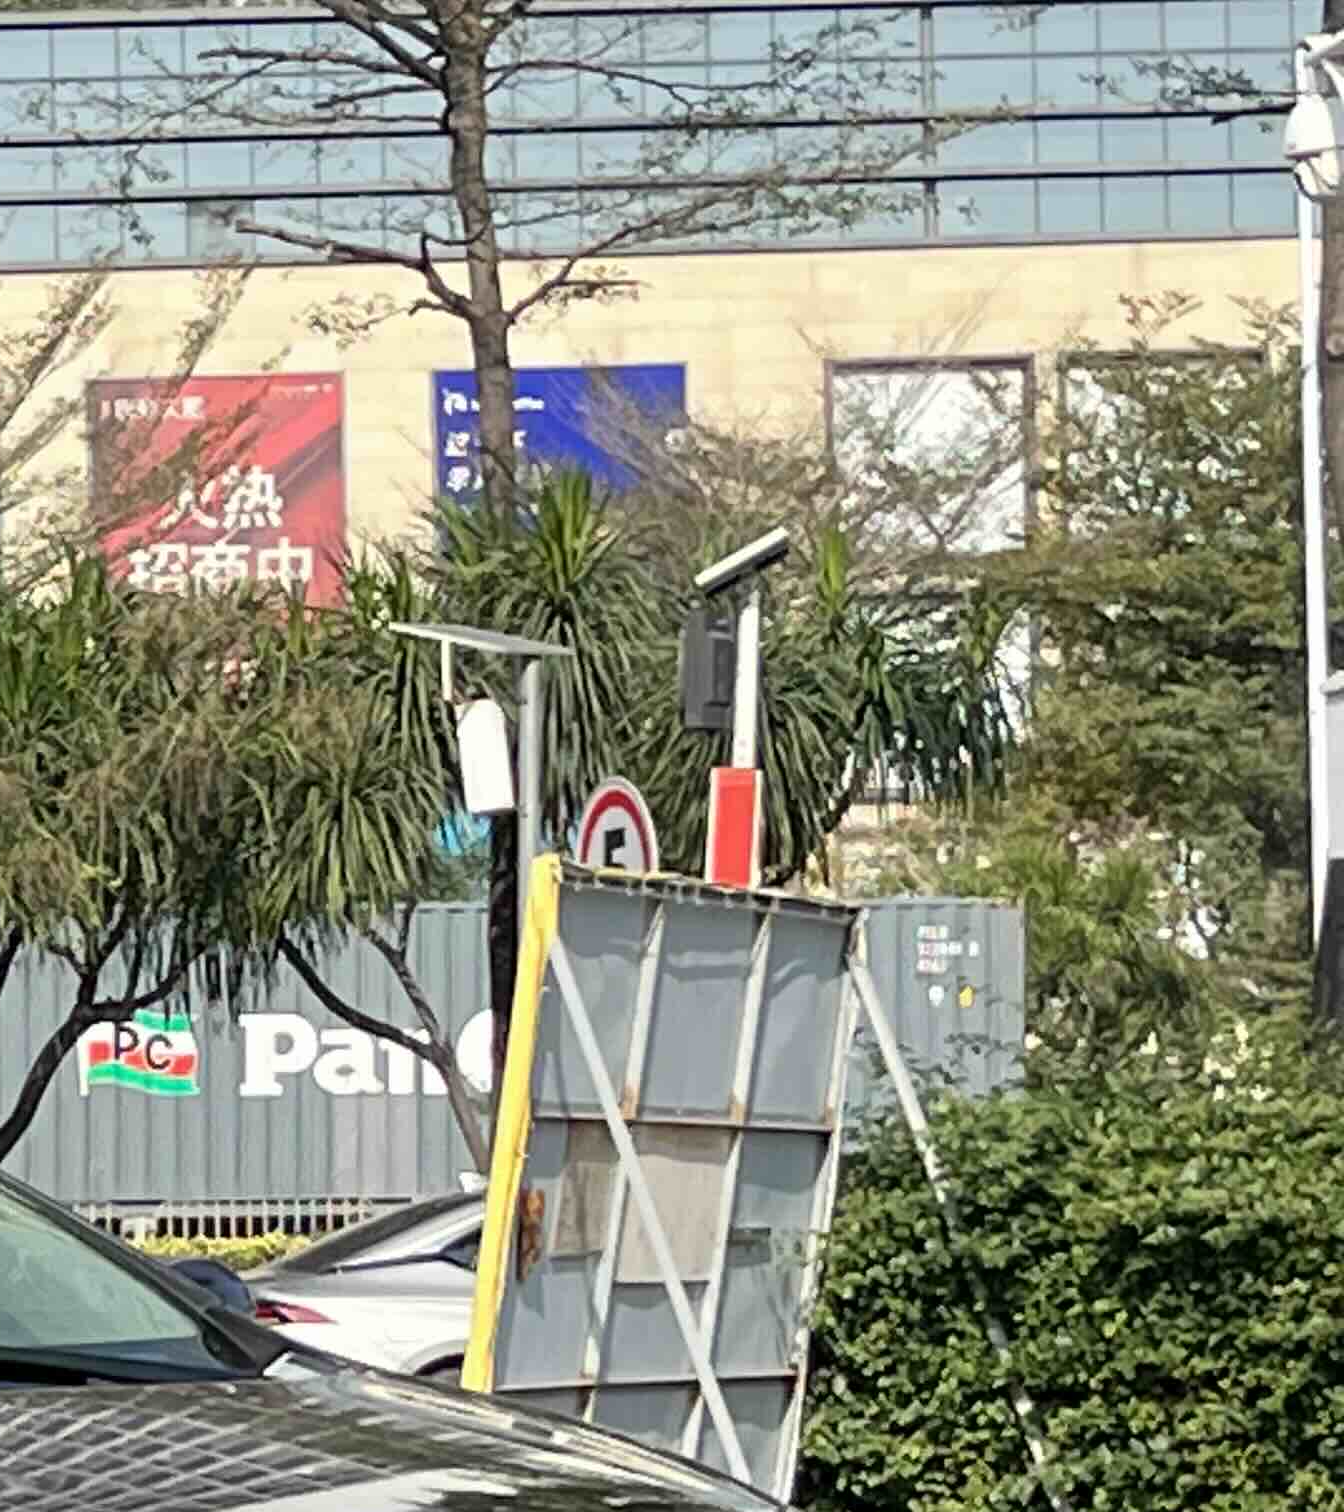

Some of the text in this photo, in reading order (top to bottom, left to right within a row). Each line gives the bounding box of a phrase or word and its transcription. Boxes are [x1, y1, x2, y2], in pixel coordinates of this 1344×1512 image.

[159, 465, 284, 529] 火热
[126, 536, 314, 600] 招商中
[114, 1021, 174, 1070] PC
